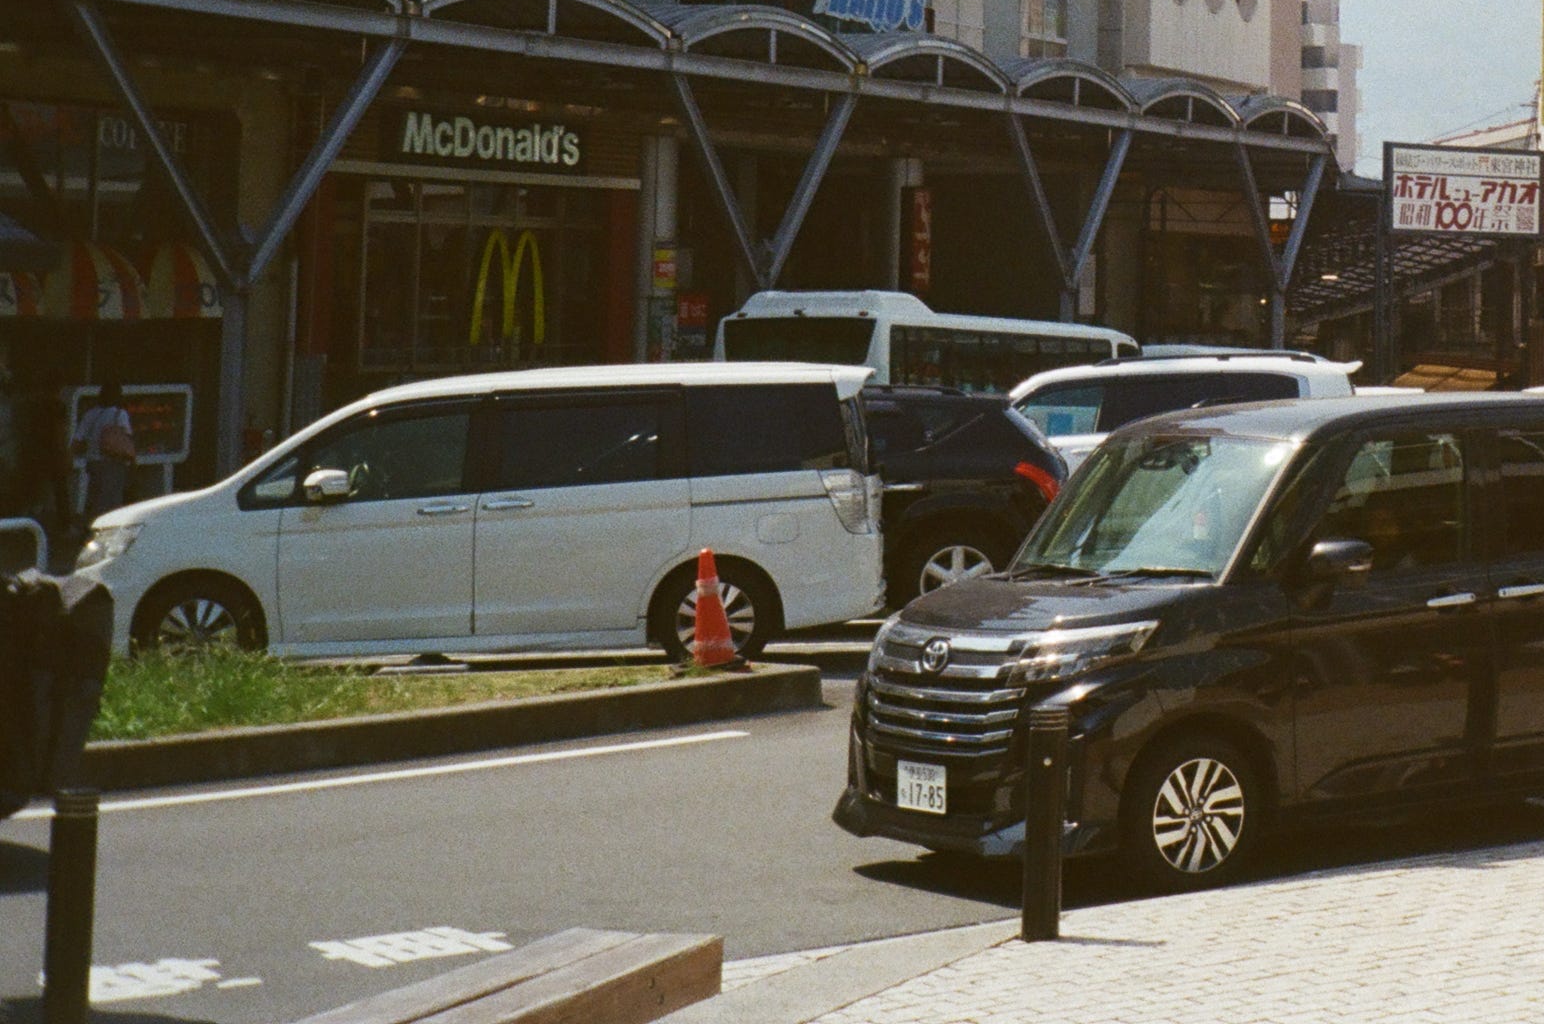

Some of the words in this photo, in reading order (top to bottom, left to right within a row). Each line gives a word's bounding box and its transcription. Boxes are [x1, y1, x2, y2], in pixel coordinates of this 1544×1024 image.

[402, 111, 580, 166] McDonald's
[1394, 174, 1540, 205] ホテルニューアカオ
[908, 779, 944, 810] 17-85
